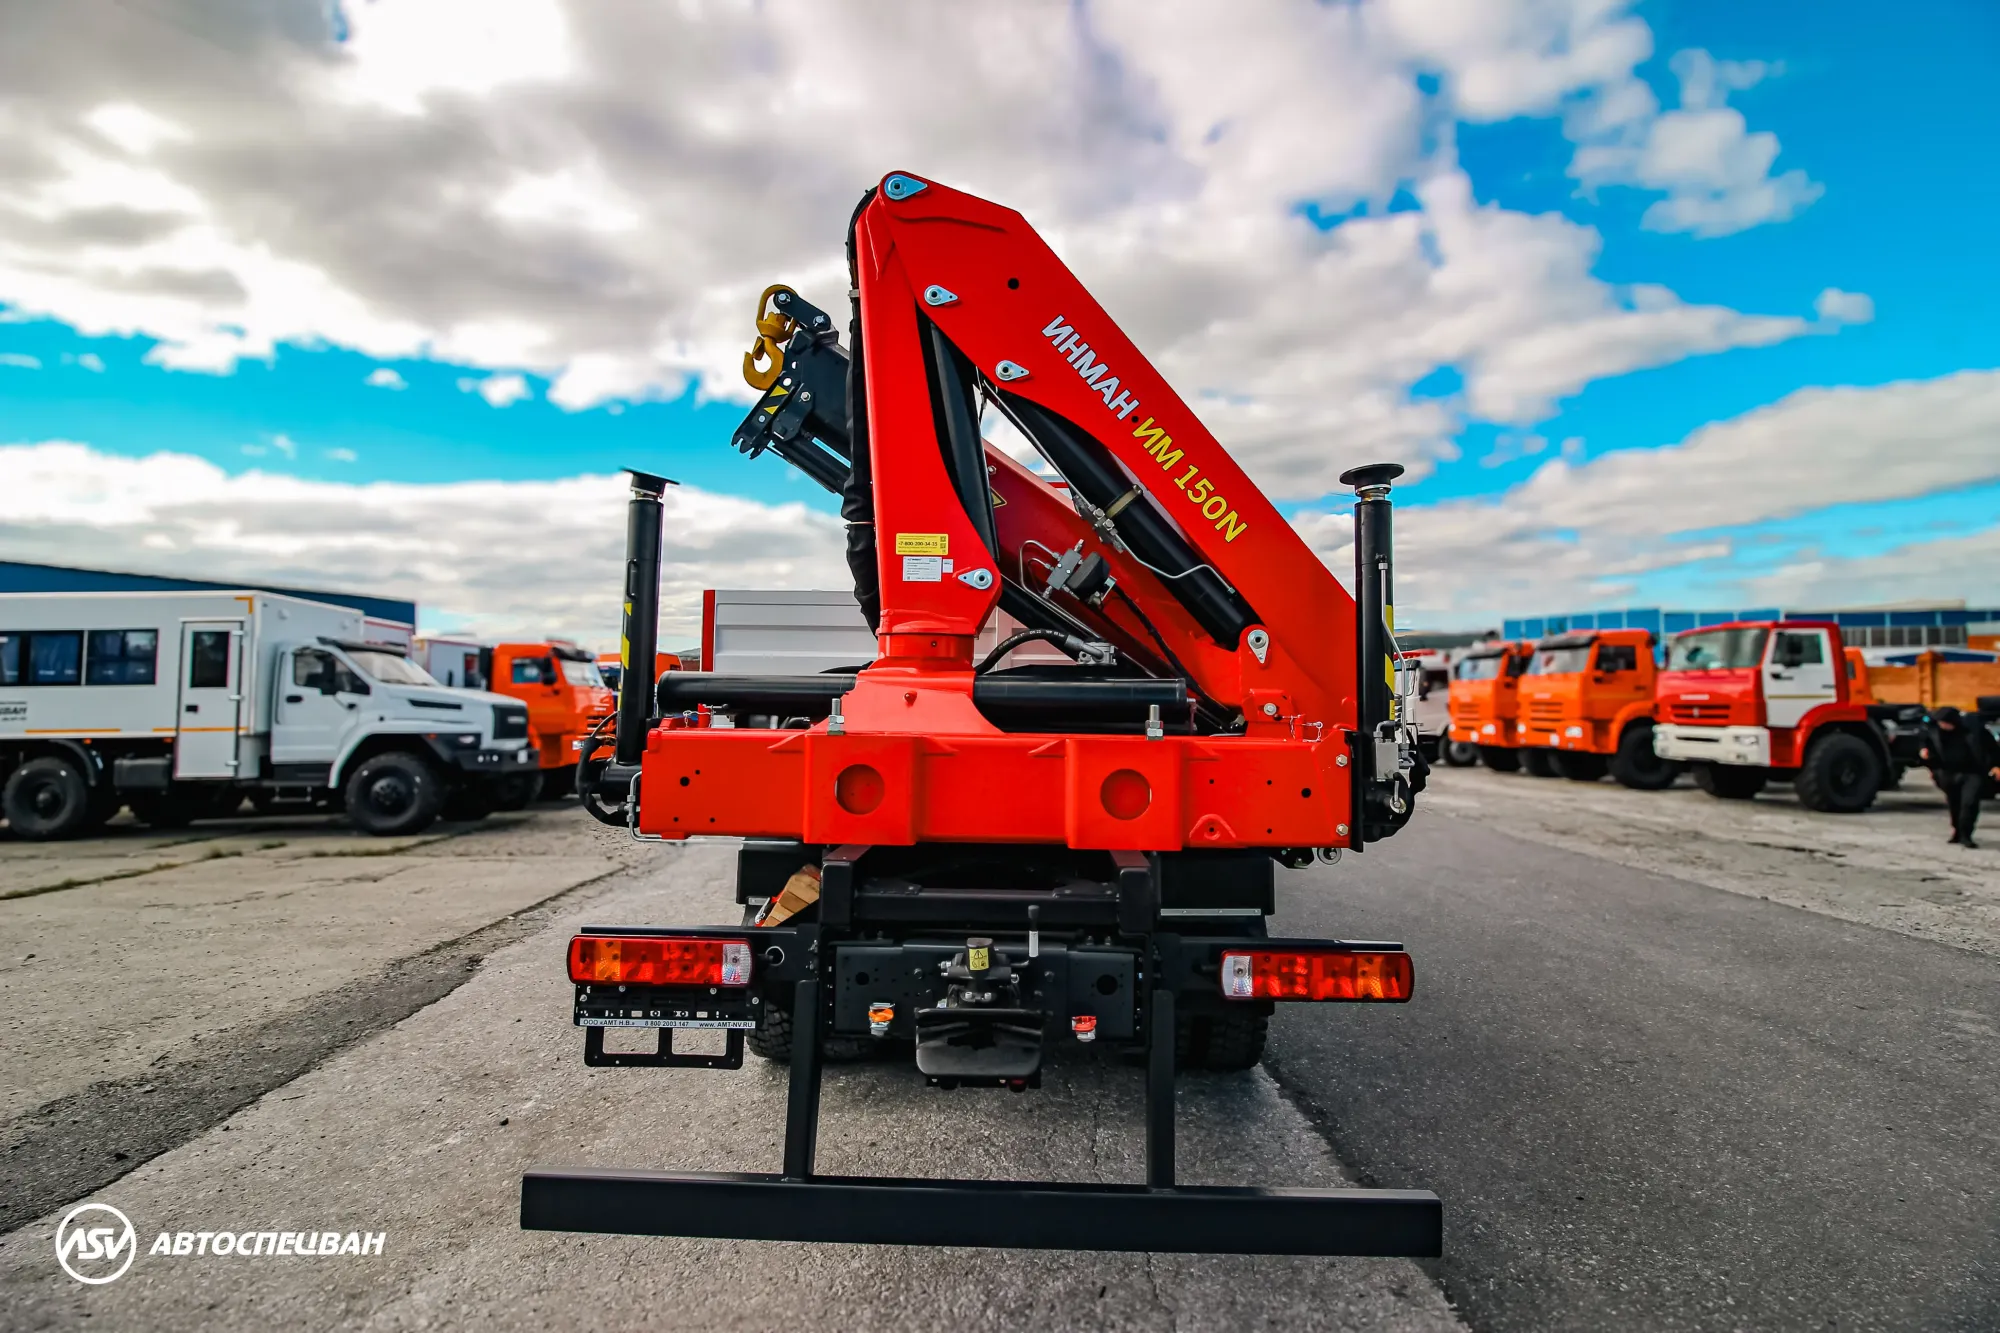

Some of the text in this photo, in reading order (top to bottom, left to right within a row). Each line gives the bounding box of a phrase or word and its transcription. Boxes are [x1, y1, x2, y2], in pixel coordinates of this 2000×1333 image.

[1041, 314, 1248, 543] ИНМАН ИМ 150N
